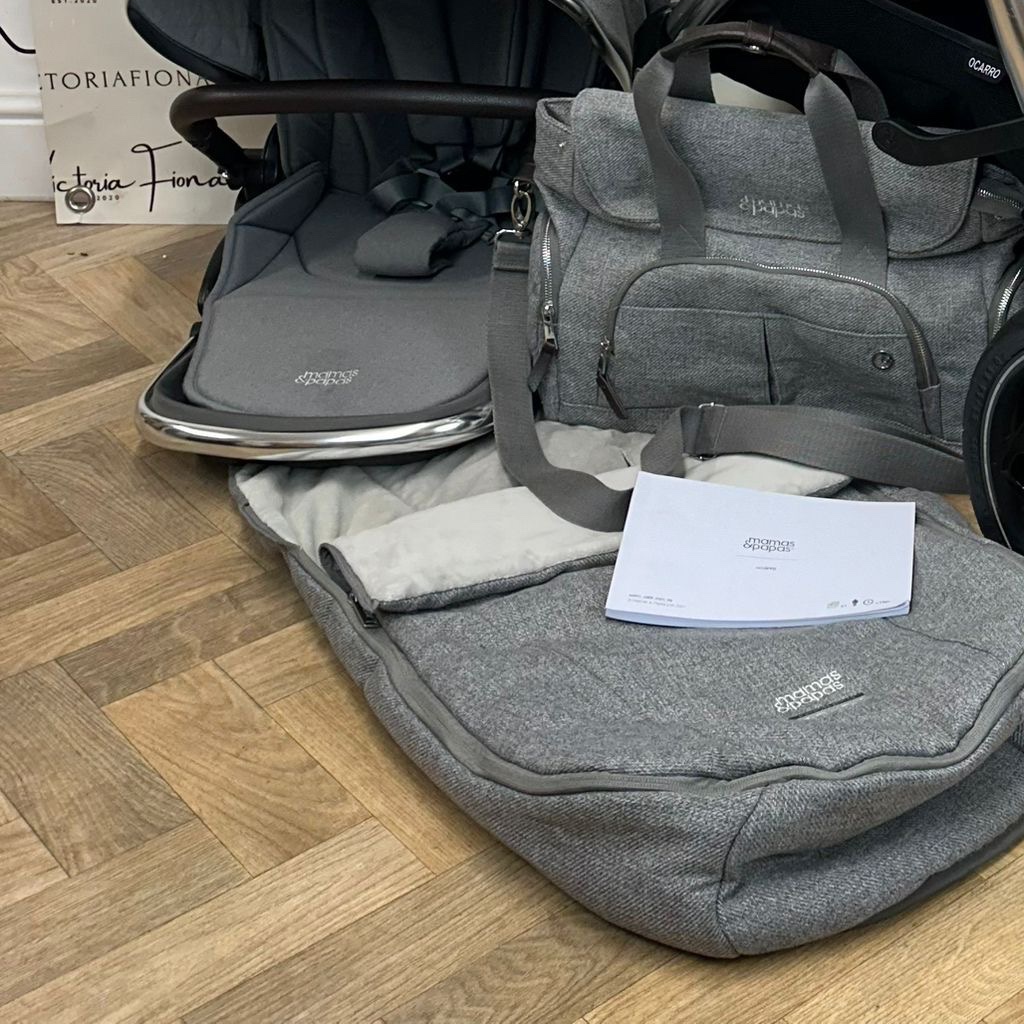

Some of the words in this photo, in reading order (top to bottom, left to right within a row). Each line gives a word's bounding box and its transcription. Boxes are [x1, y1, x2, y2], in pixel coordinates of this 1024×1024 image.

[968, 57, 1001, 80] OCARRO
[49, 150, 136, 192] ictoria
[131, 141, 229, 212] Fiona
[743, 540, 791, 553] &papas
[748, 537, 795, 547] mamas
[775, 670, 841, 705] mamas
[775, 681, 845, 713] &papas
